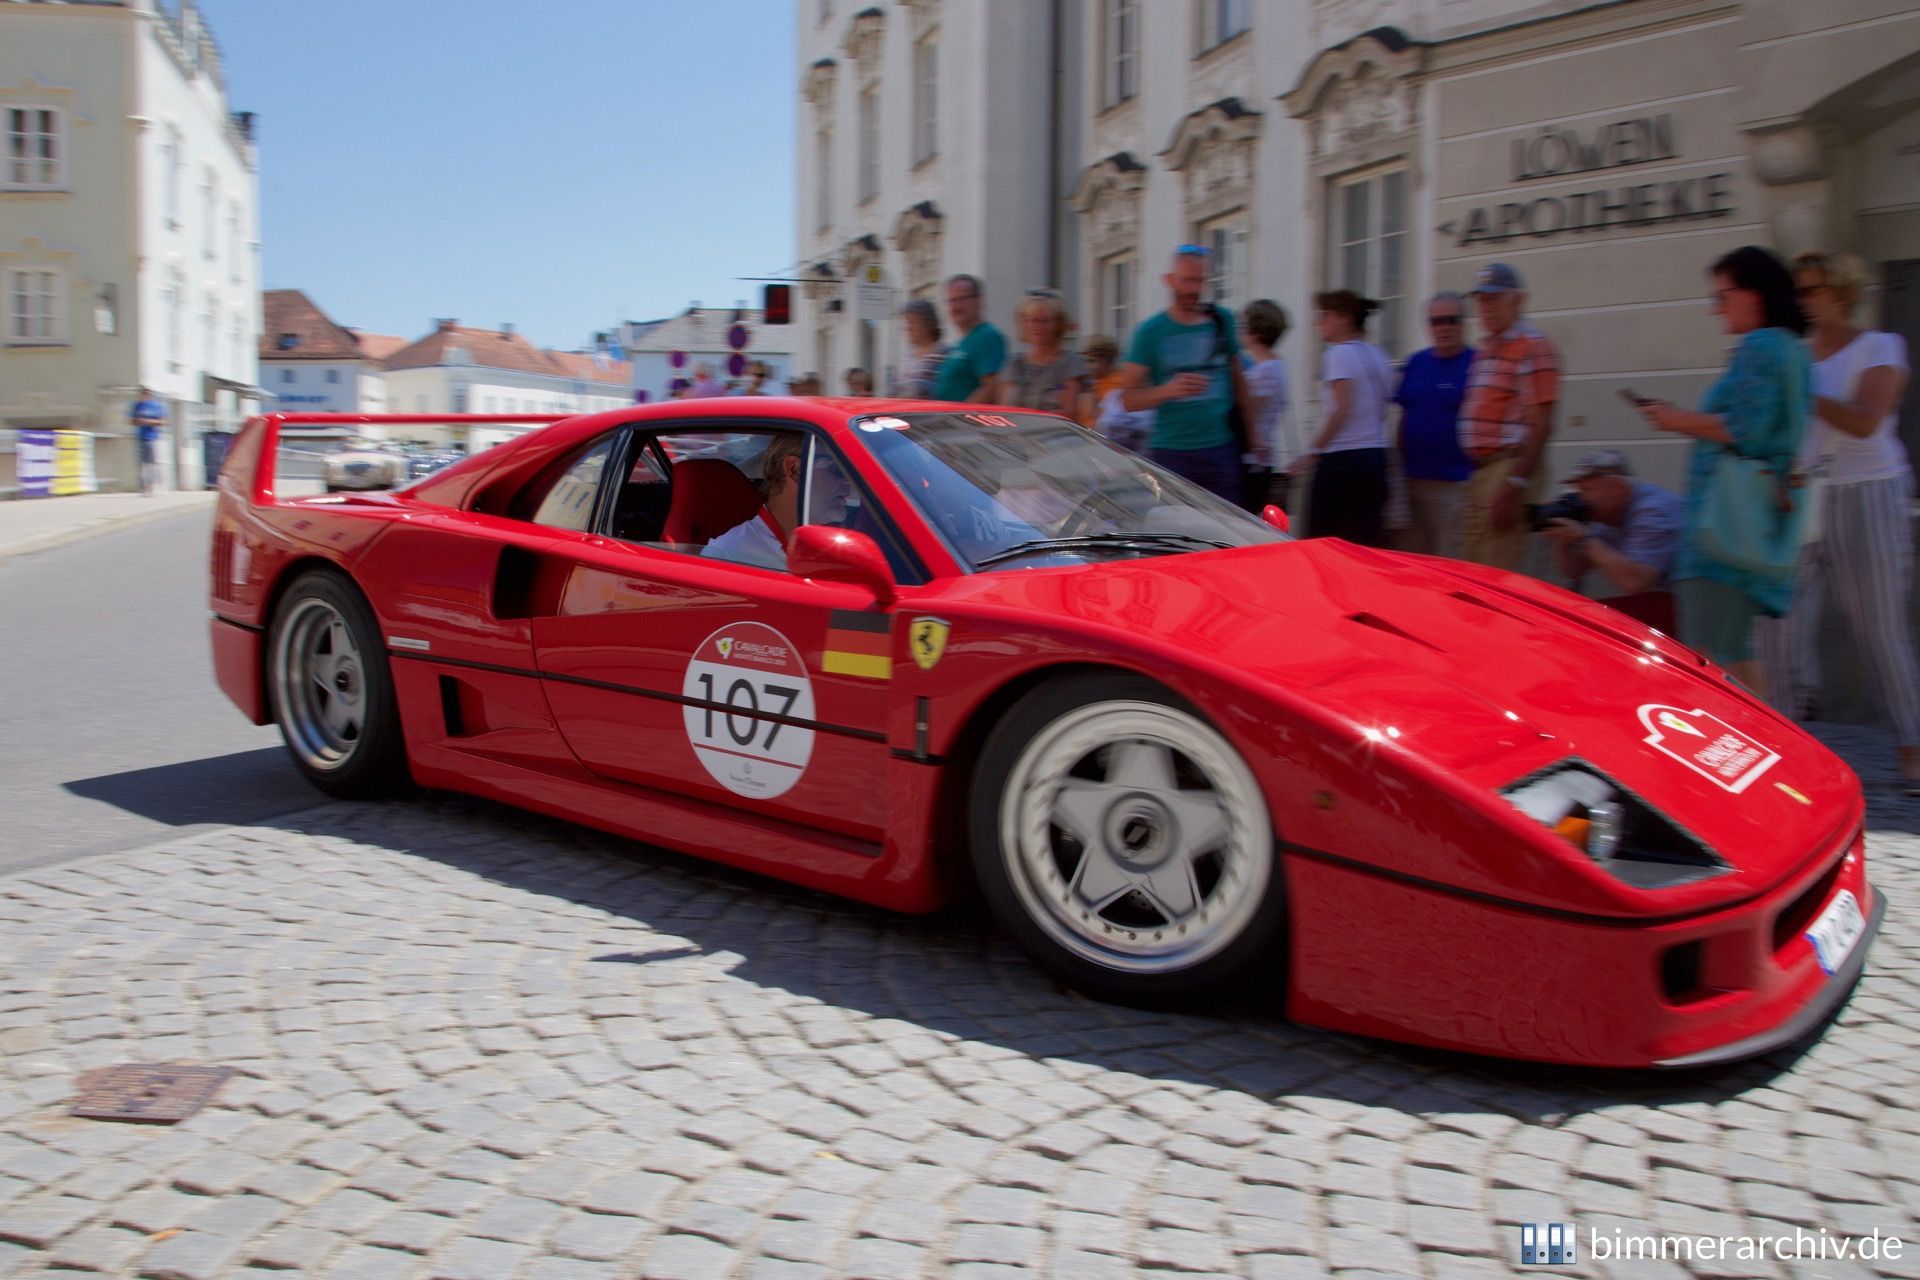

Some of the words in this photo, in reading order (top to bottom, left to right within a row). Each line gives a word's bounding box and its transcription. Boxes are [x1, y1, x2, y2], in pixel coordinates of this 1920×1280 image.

[1511, 114, 1678, 182] LÖWEN
[1457, 173, 1738, 247] APOTHEKE
[965, 415, 1017, 427] 107
[698, 673, 800, 751] 107
